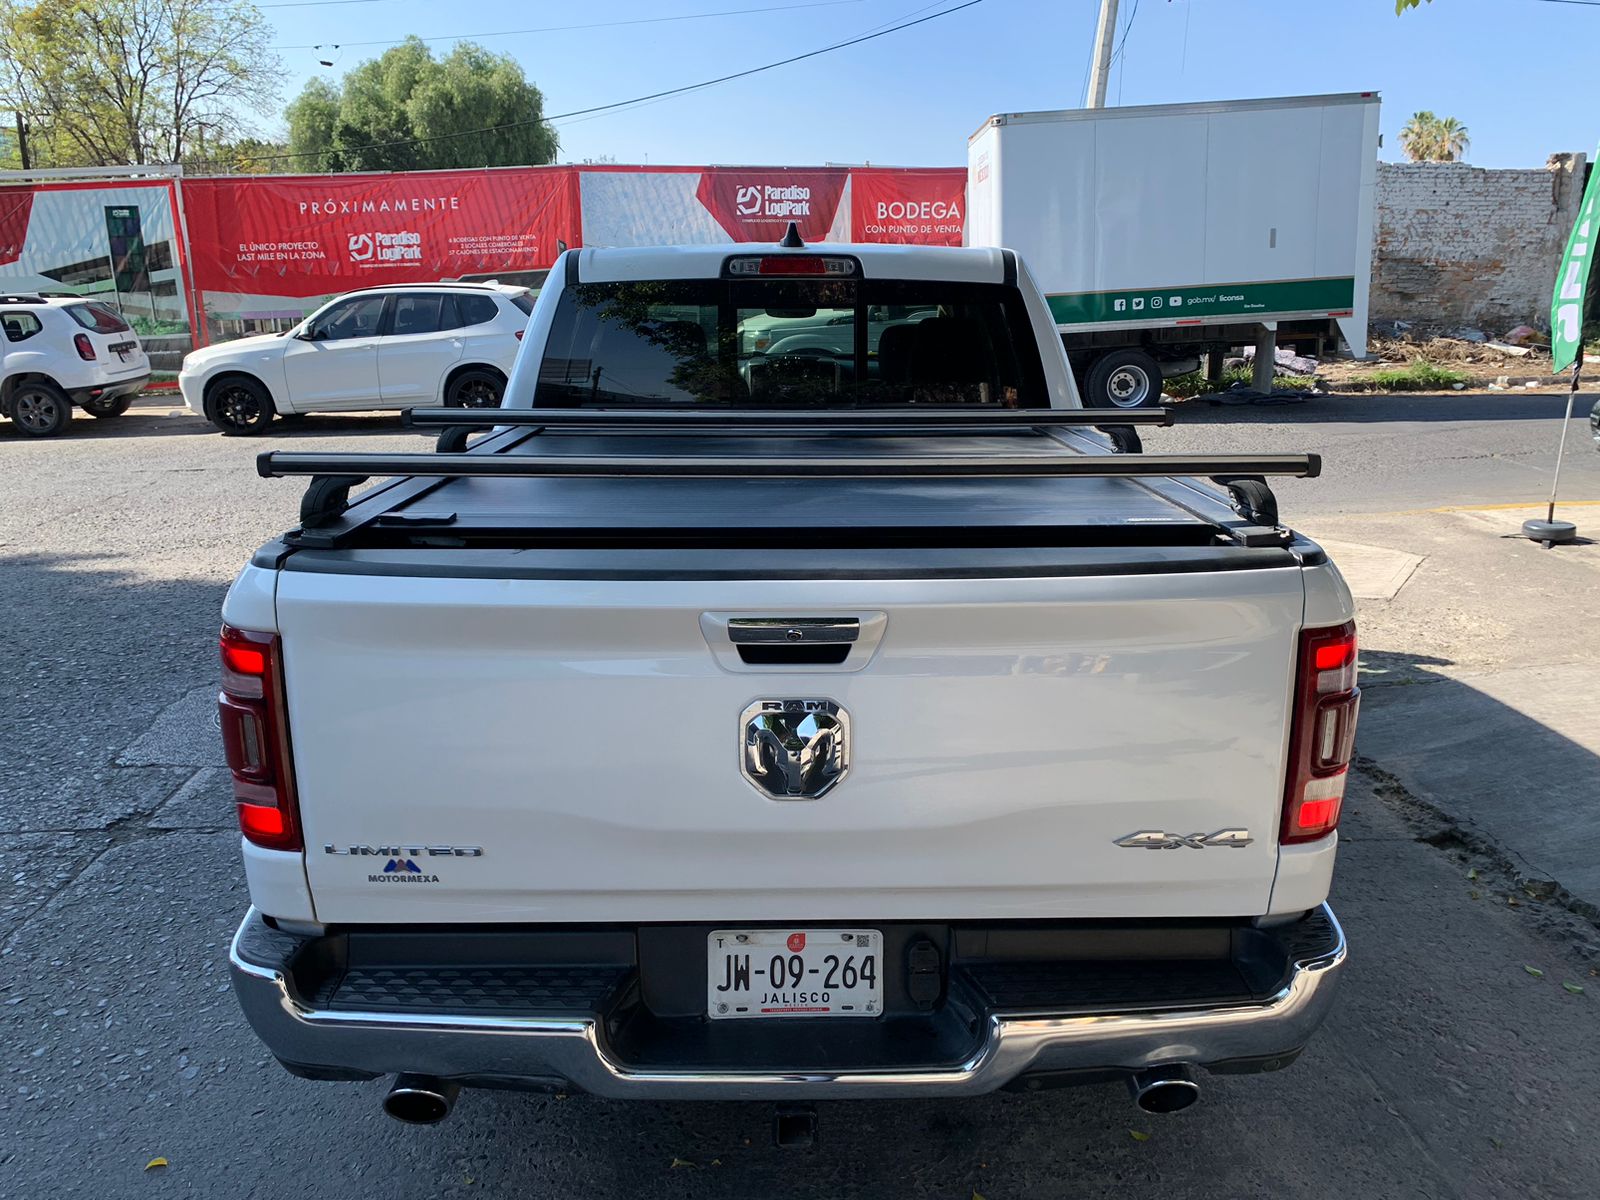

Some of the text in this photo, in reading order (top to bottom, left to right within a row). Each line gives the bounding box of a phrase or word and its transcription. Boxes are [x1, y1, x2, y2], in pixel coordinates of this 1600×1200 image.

[764, 185, 810, 200] Paradiso
[299, 197, 459, 214] PRÓXIMAMENTE
[765, 201, 810, 217] LogiPark
[877, 202, 961, 219] BODEGA
[865, 225, 962, 233] CON PUNTO DE VENTA
[375, 231, 421, 246] Paradiso
[519, 233, 537, 241] VENTA
[240, 242, 319, 252] EL ÚNICO PROYECTO
[489, 246, 539, 254] ESTACIONAMIENTO
[237, 251, 326, 262] LAST MILE EN LA ZONA
[377, 245, 423, 261] LogiPark
[1187, 295, 1217, 306] gob.mx/
[761, 701, 828, 712] RAM
[324, 843, 485, 857] LIMITED
[368, 874, 440, 883] MOTORMEXA
[716, 938, 725, 949] T
[716, 954, 877, 992] JW-09-264
[760, 992, 831, 1004] JALISCO
